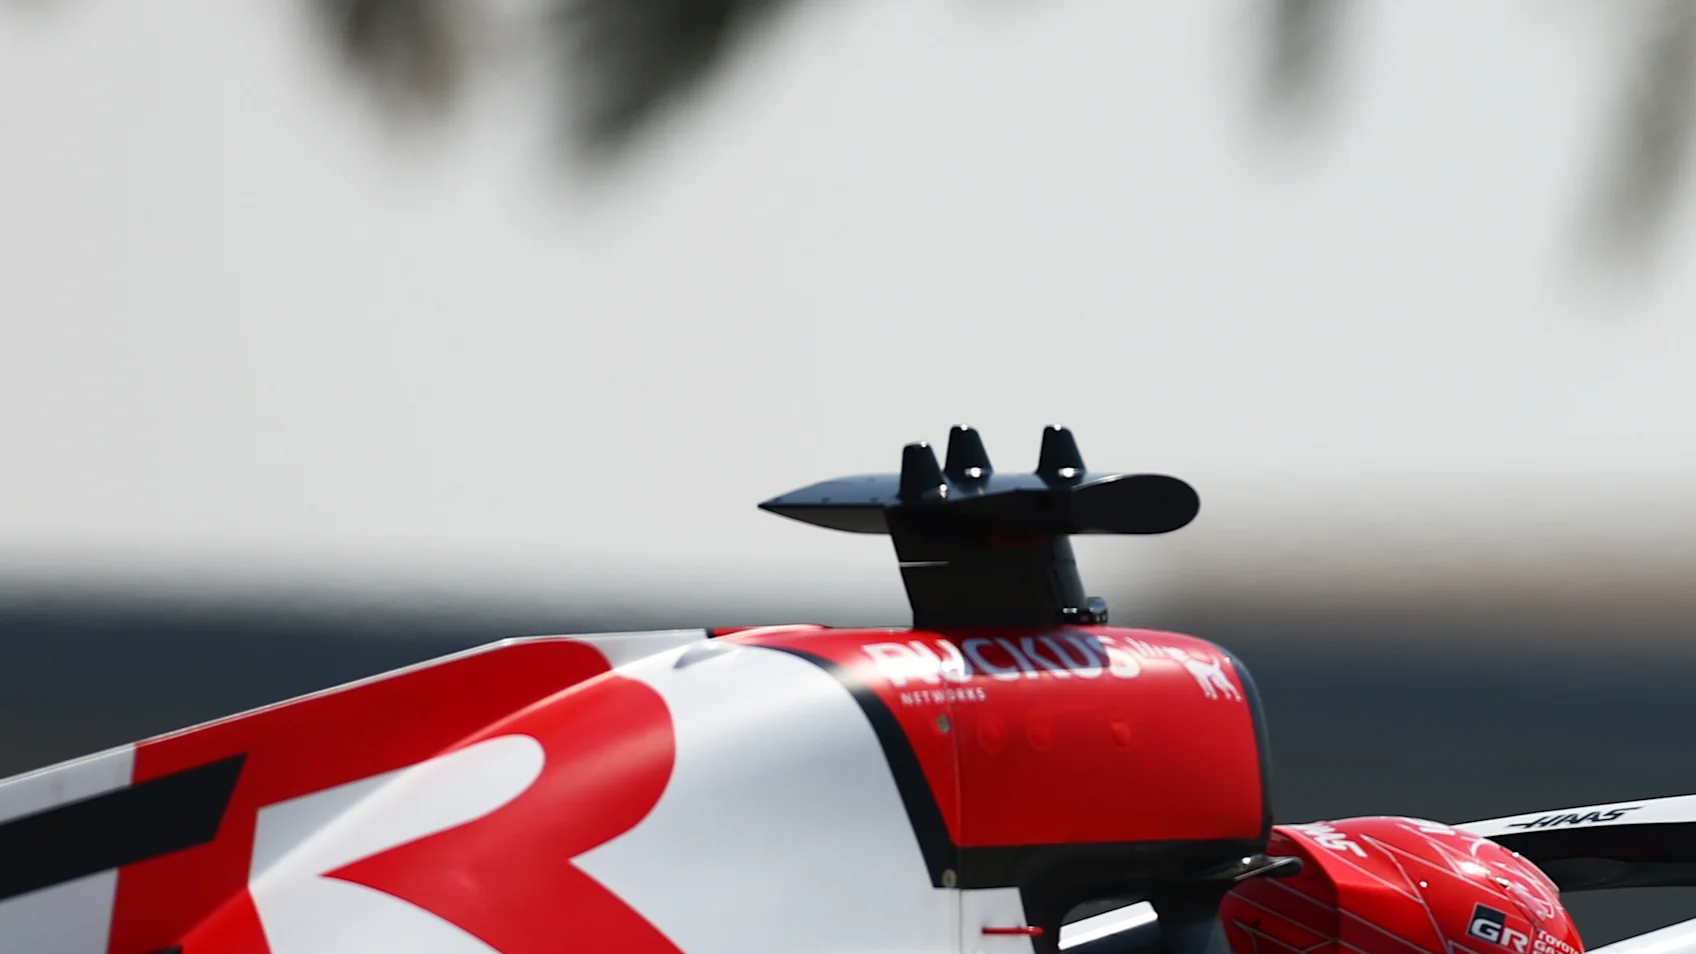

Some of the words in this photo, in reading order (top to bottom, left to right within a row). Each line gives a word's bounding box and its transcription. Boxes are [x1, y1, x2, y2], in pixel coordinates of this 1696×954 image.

[861, 635, 1141, 687] RUCKUS
[901, 686, 986, 706] NETWORKS
[1503, 805, 1646, 829] HAAS
[1470, 918, 1529, 954] GR
